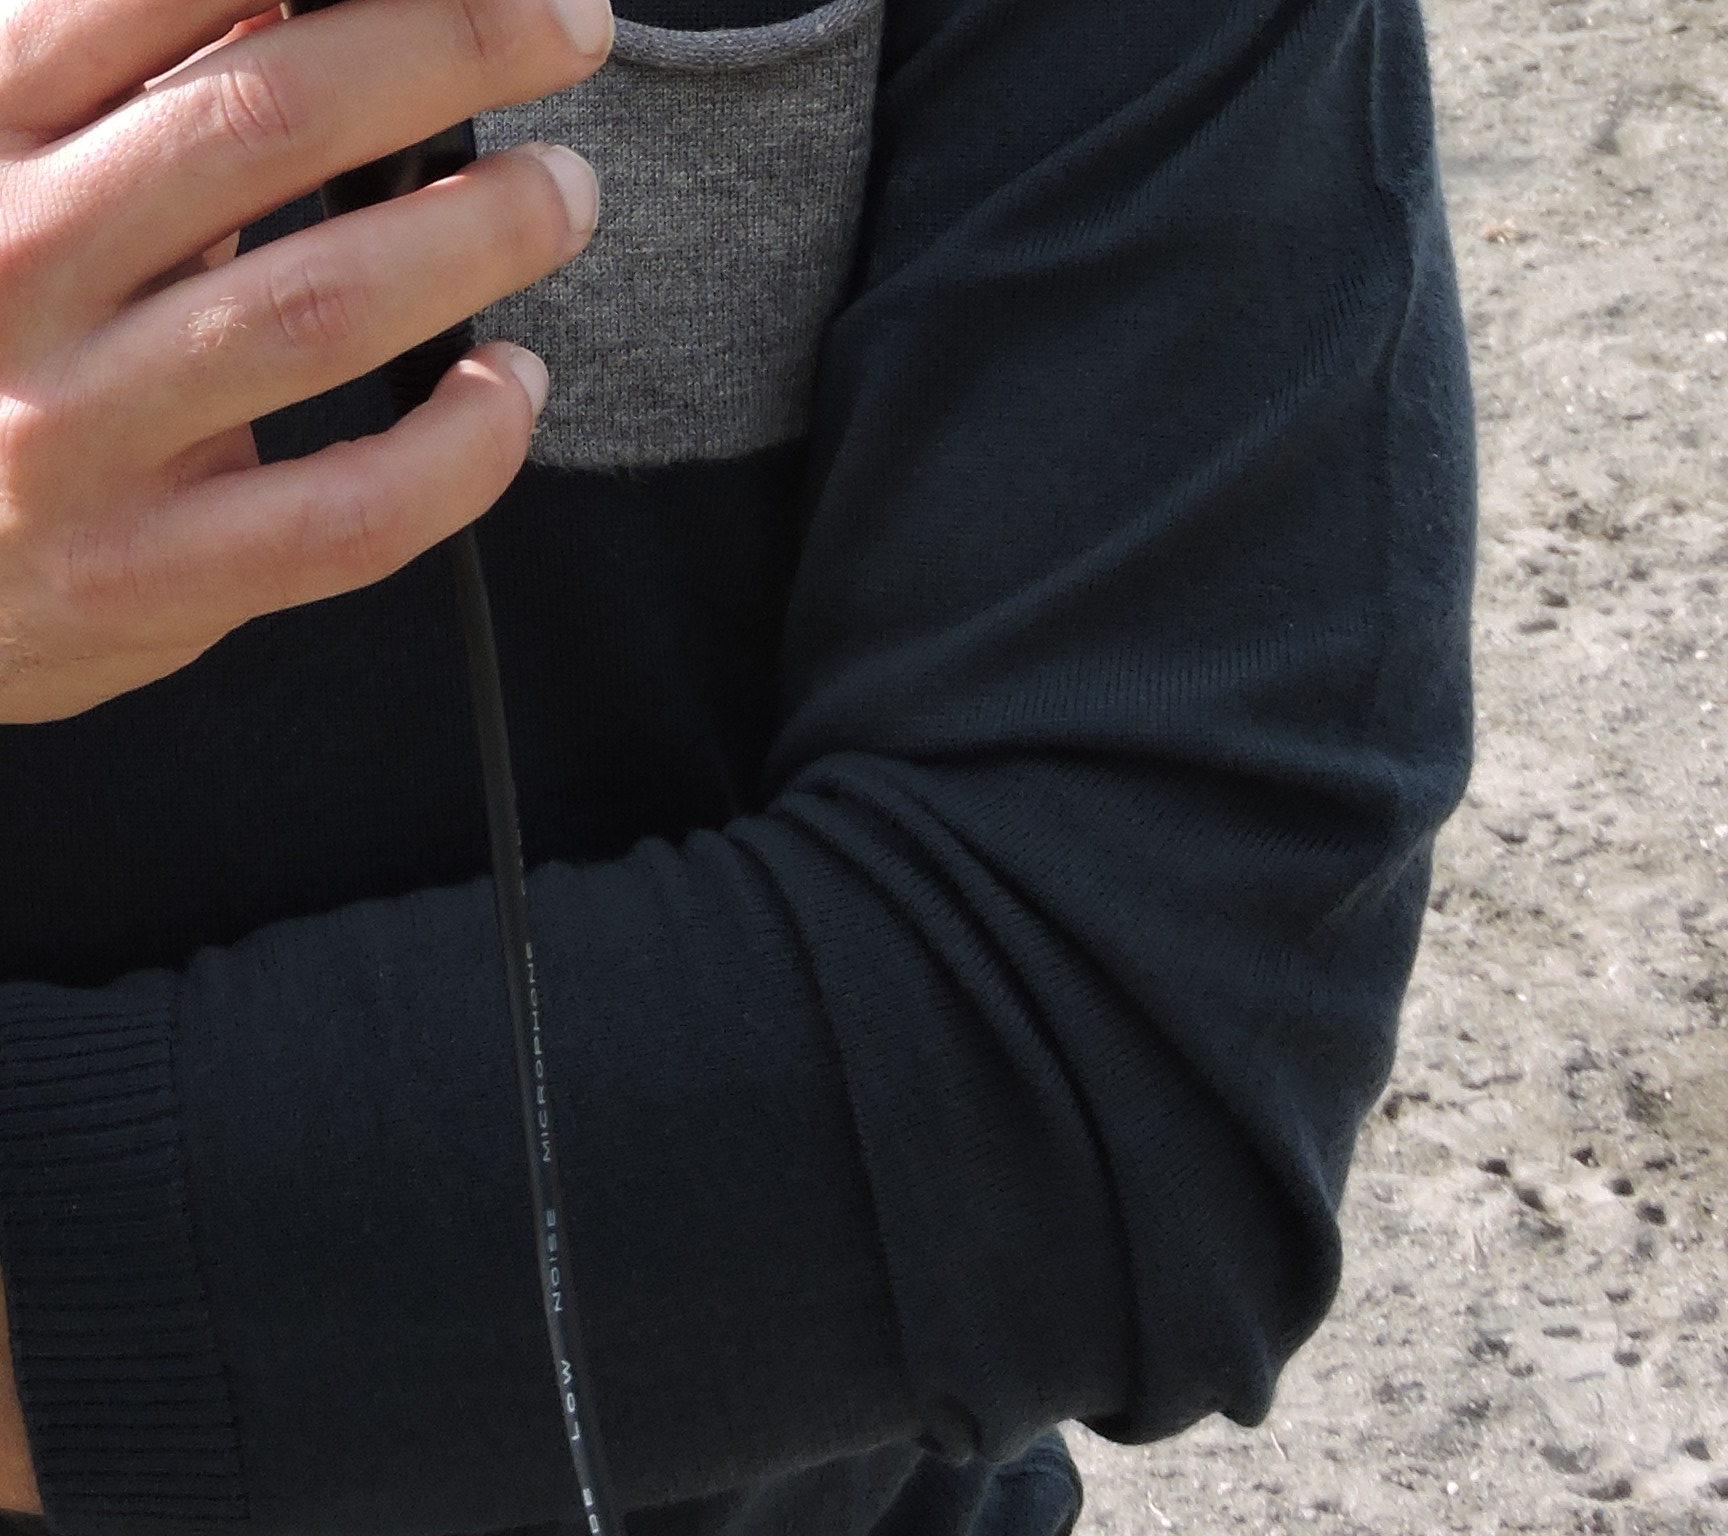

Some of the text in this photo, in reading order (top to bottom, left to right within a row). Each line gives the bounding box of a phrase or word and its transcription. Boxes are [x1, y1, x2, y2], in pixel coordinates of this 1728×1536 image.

[525, 942, 552, 1162] MICROPHONE
[545, 1208, 564, 1312] NOISE
[561, 1360, 581, 1441] LOW
